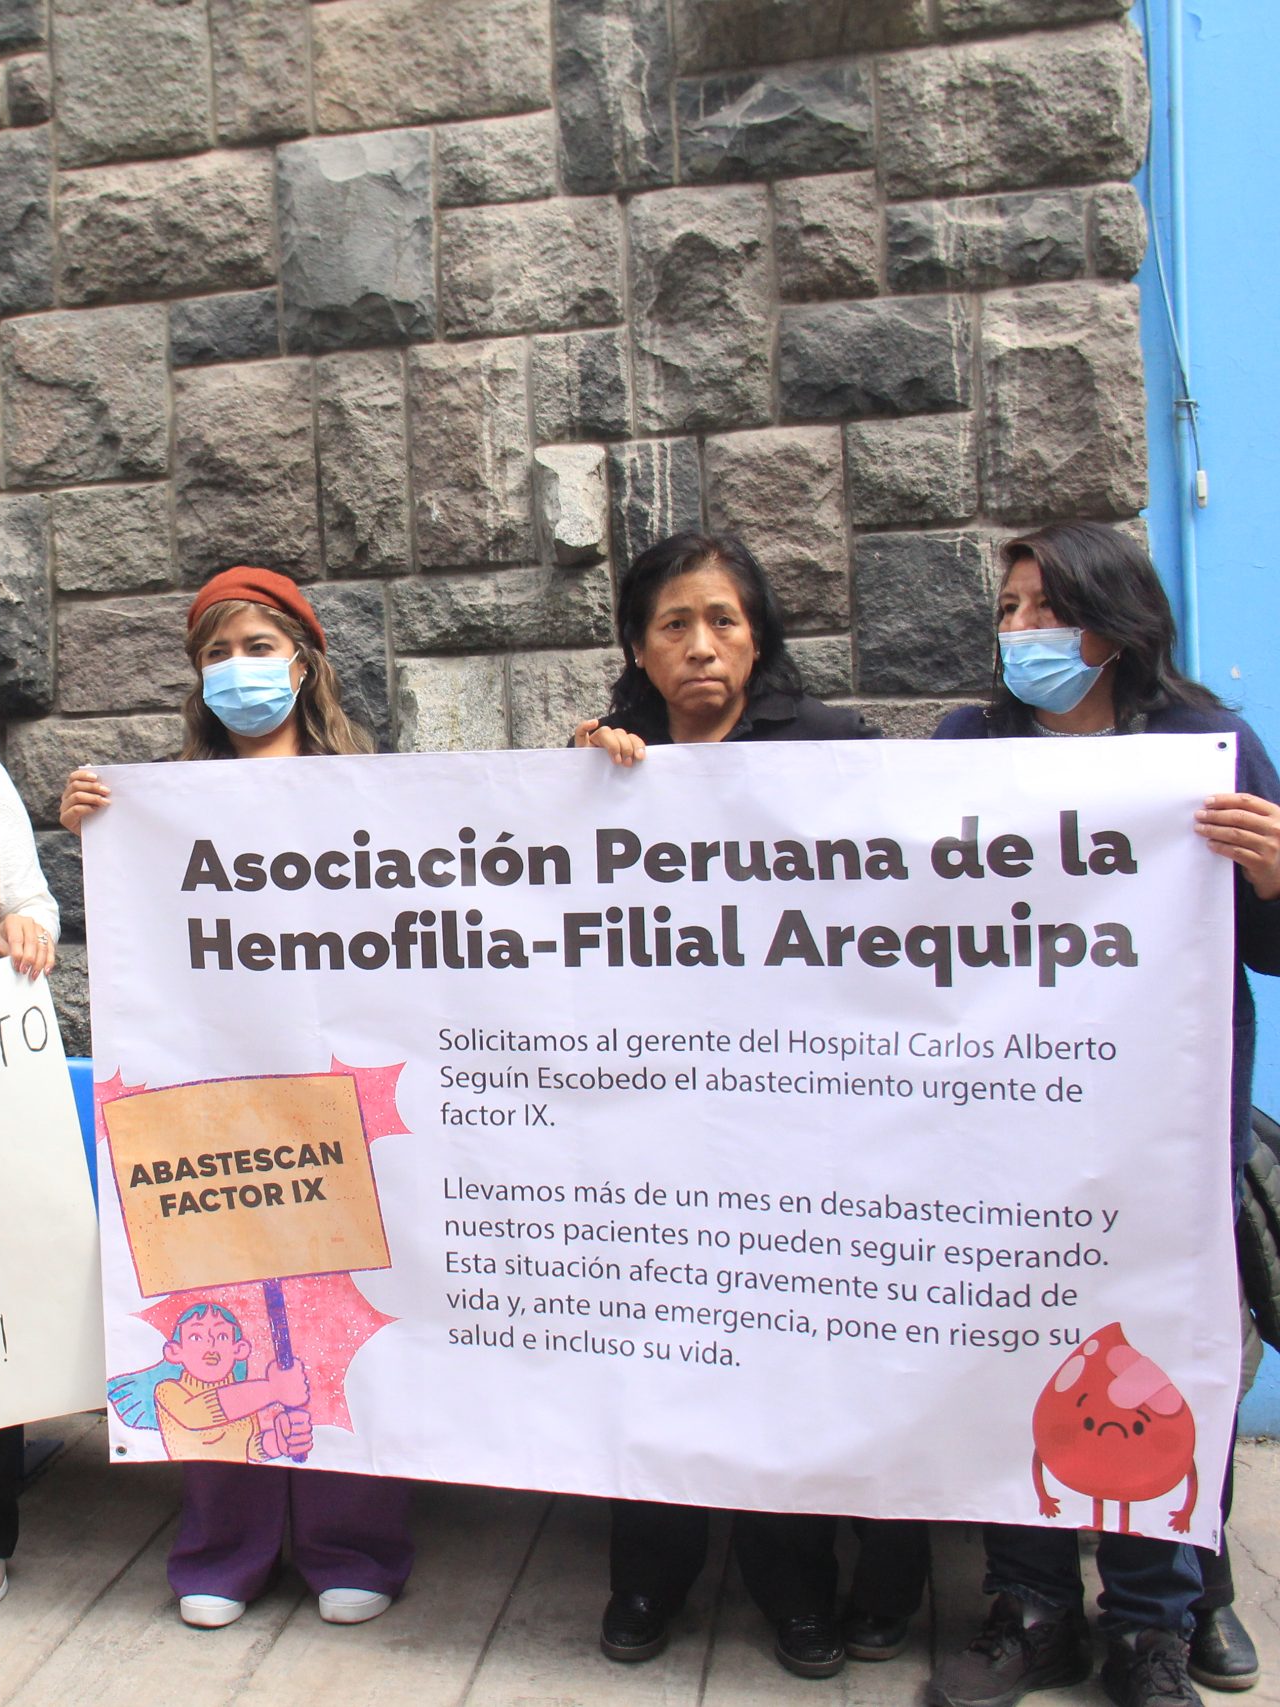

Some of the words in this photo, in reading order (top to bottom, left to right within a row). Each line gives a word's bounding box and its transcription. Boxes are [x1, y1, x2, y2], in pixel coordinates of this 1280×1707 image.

[180, 826, 572, 893] Asociación
[595, 828, 909, 884] Peruana
[930, 815, 1035, 880] de
[1059, 809, 1138, 877] la
[187, 904, 746, 972] Hemofilia-Filial
[763, 901, 1139, 988] Arequipa
[438, 1027, 588, 1052] Solicitamos
[596, 1027, 618, 1052] al
[626, 1030, 731, 1059] gerente
[738, 1028, 779, 1053] del
[788, 1029, 899, 1062] Hospital
[908, 1032, 995, 1059] Carlos
[1003, 1033, 1117, 1061] Alberto
[440, 1065, 529, 1095] Seguín
[537, 1066, 667, 1090] Escobedo
[674, 1066, 697, 1091] el
[705, 1067, 914, 1098] abastecimiento
[922, 1078, 1036, 1107] urgente
[1045, 1076, 1083, 1103] de
[440, 1101, 517, 1127] factor
[525, 1103, 555, 1127] IX.
[129, 1140, 344, 1189] ABASTESCAN
[159, 1182, 286, 1218] FACTOR
[291, 1176, 328, 1204] IX
[444, 1176, 566, 1203] Llevamos
[574, 1180, 626, 1205] más
[634, 1181, 667, 1206] de
[676, 1189, 709, 1208] un
[718, 1191, 771, 1212] mes
[779, 1195, 812, 1214] en
[820, 1190, 1093, 1228] desabastecimiento
[1101, 1209, 1119, 1234] y
[445, 1218, 555, 1240] nuestros
[563, 1219, 689, 1246] pacientes
[697, 1229, 731, 1248] no
[739, 1228, 841, 1256] pueden
[850, 1237, 936, 1267] seguir
[944, 1242, 1109, 1273] esperando.
[446, 1251, 497, 1275] Esta
[505, 1253, 621, 1281] situación
[629, 1258, 708, 1286] afecta
[716, 1270, 879, 1300] gravemente
[887, 1282, 917, 1302] su
[926, 1280, 1031, 1309] calidad
[1040, 1282, 1078, 1308] de
[446, 1287, 499, 1311] vida
[506, 1295, 526, 1318] y,
[533, 1294, 591, 1316] ante
[599, 1300, 646, 1320] una
[654, 1304, 817, 1338] emergencia,
[826, 1317, 897, 1342] pone
[905, 1324, 939, 1345] en
[950, 1322, 1040, 1353] riesgo
[1049, 1327, 1082, 1348] su
[448, 1323, 514, 1348] salud
[522, 1333, 537, 1350] e
[545, 1329, 635, 1357] incluso
[643, 1341, 670, 1361] su
[678, 1340, 741, 1367] vida.
